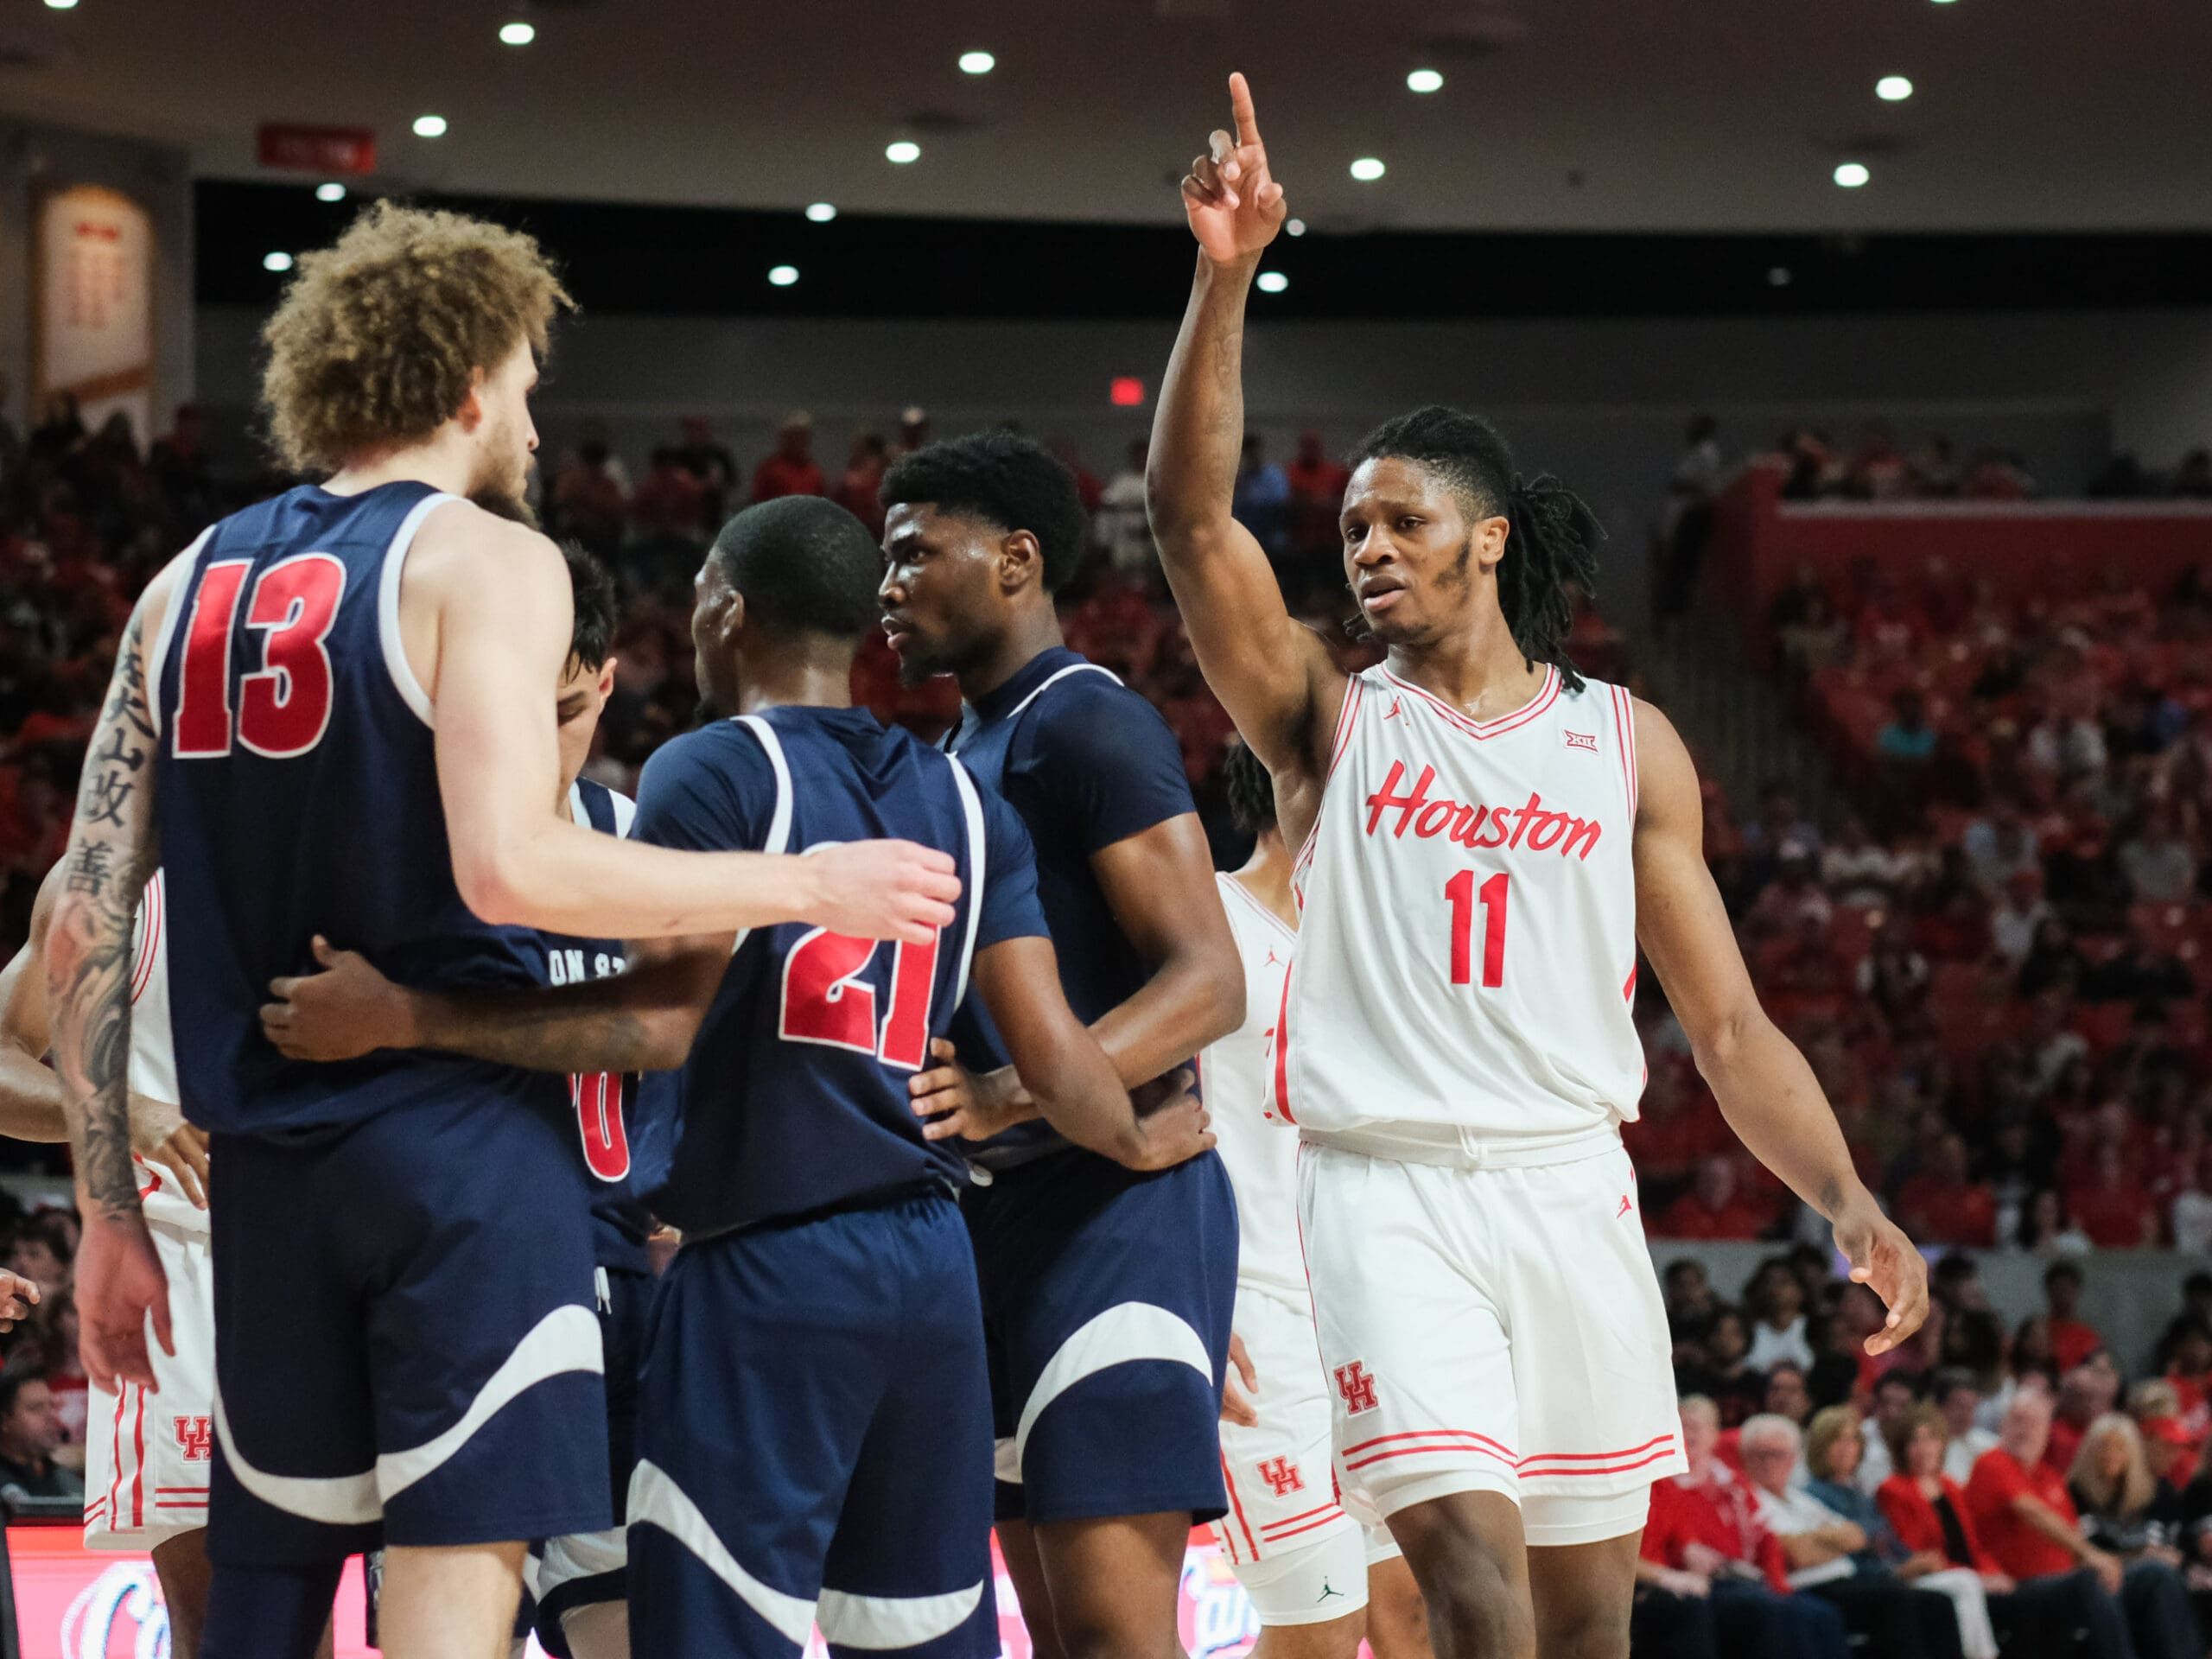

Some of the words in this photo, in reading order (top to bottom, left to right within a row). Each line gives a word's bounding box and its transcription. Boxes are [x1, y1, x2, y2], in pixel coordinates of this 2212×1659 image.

[173, 551, 347, 759] 13
[1365, 760, 1601, 861] Houston
[779, 842, 941, 1071] 21
[1445, 869, 1510, 988] 11
[567, 1071, 631, 1183] 0
[1333, 1360, 1378, 1415] UH
[1256, 1454, 1306, 1497] UH
